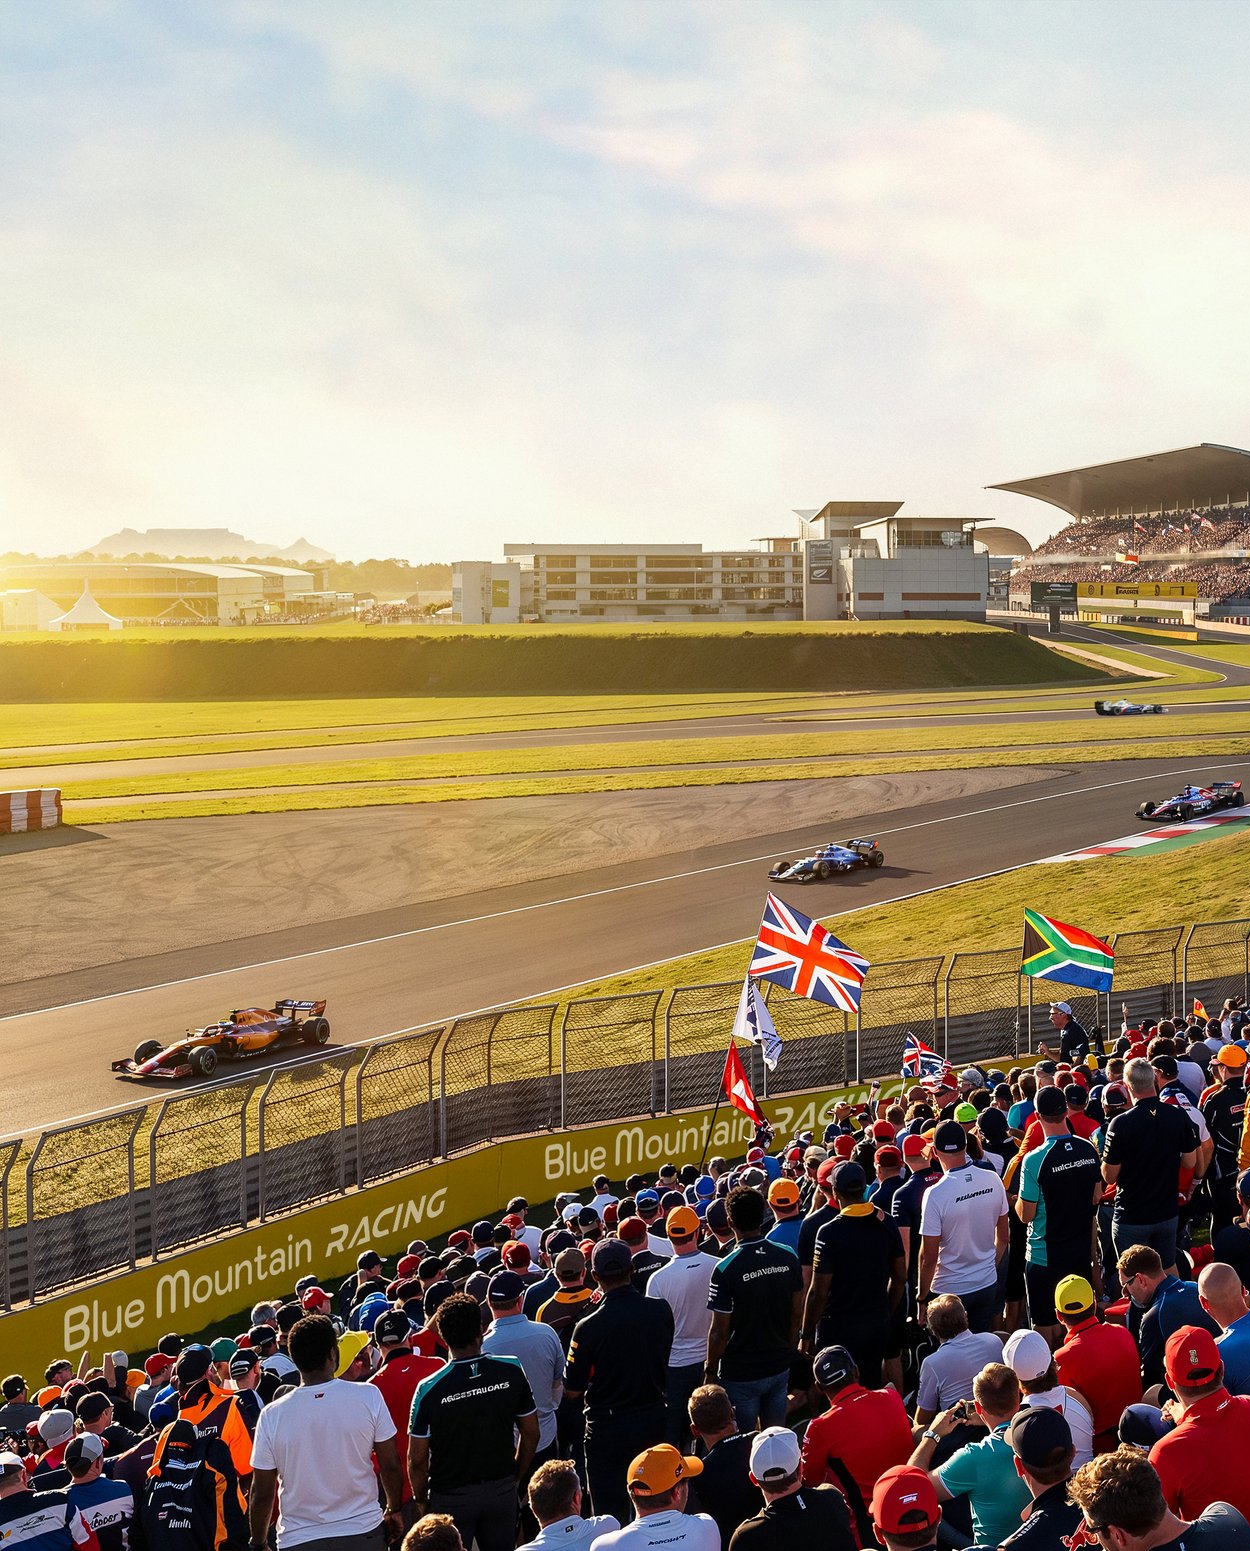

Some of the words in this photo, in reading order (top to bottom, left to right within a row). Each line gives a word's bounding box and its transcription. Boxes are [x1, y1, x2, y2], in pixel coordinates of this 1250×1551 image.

[545, 1142, 606, 1180] Blue
[614, 1109, 756, 1166] Mountain
[63, 1300, 145, 1352] Blue
[155, 1234, 312, 1319] Mountain
[325, 1186, 448, 1258] RACING
